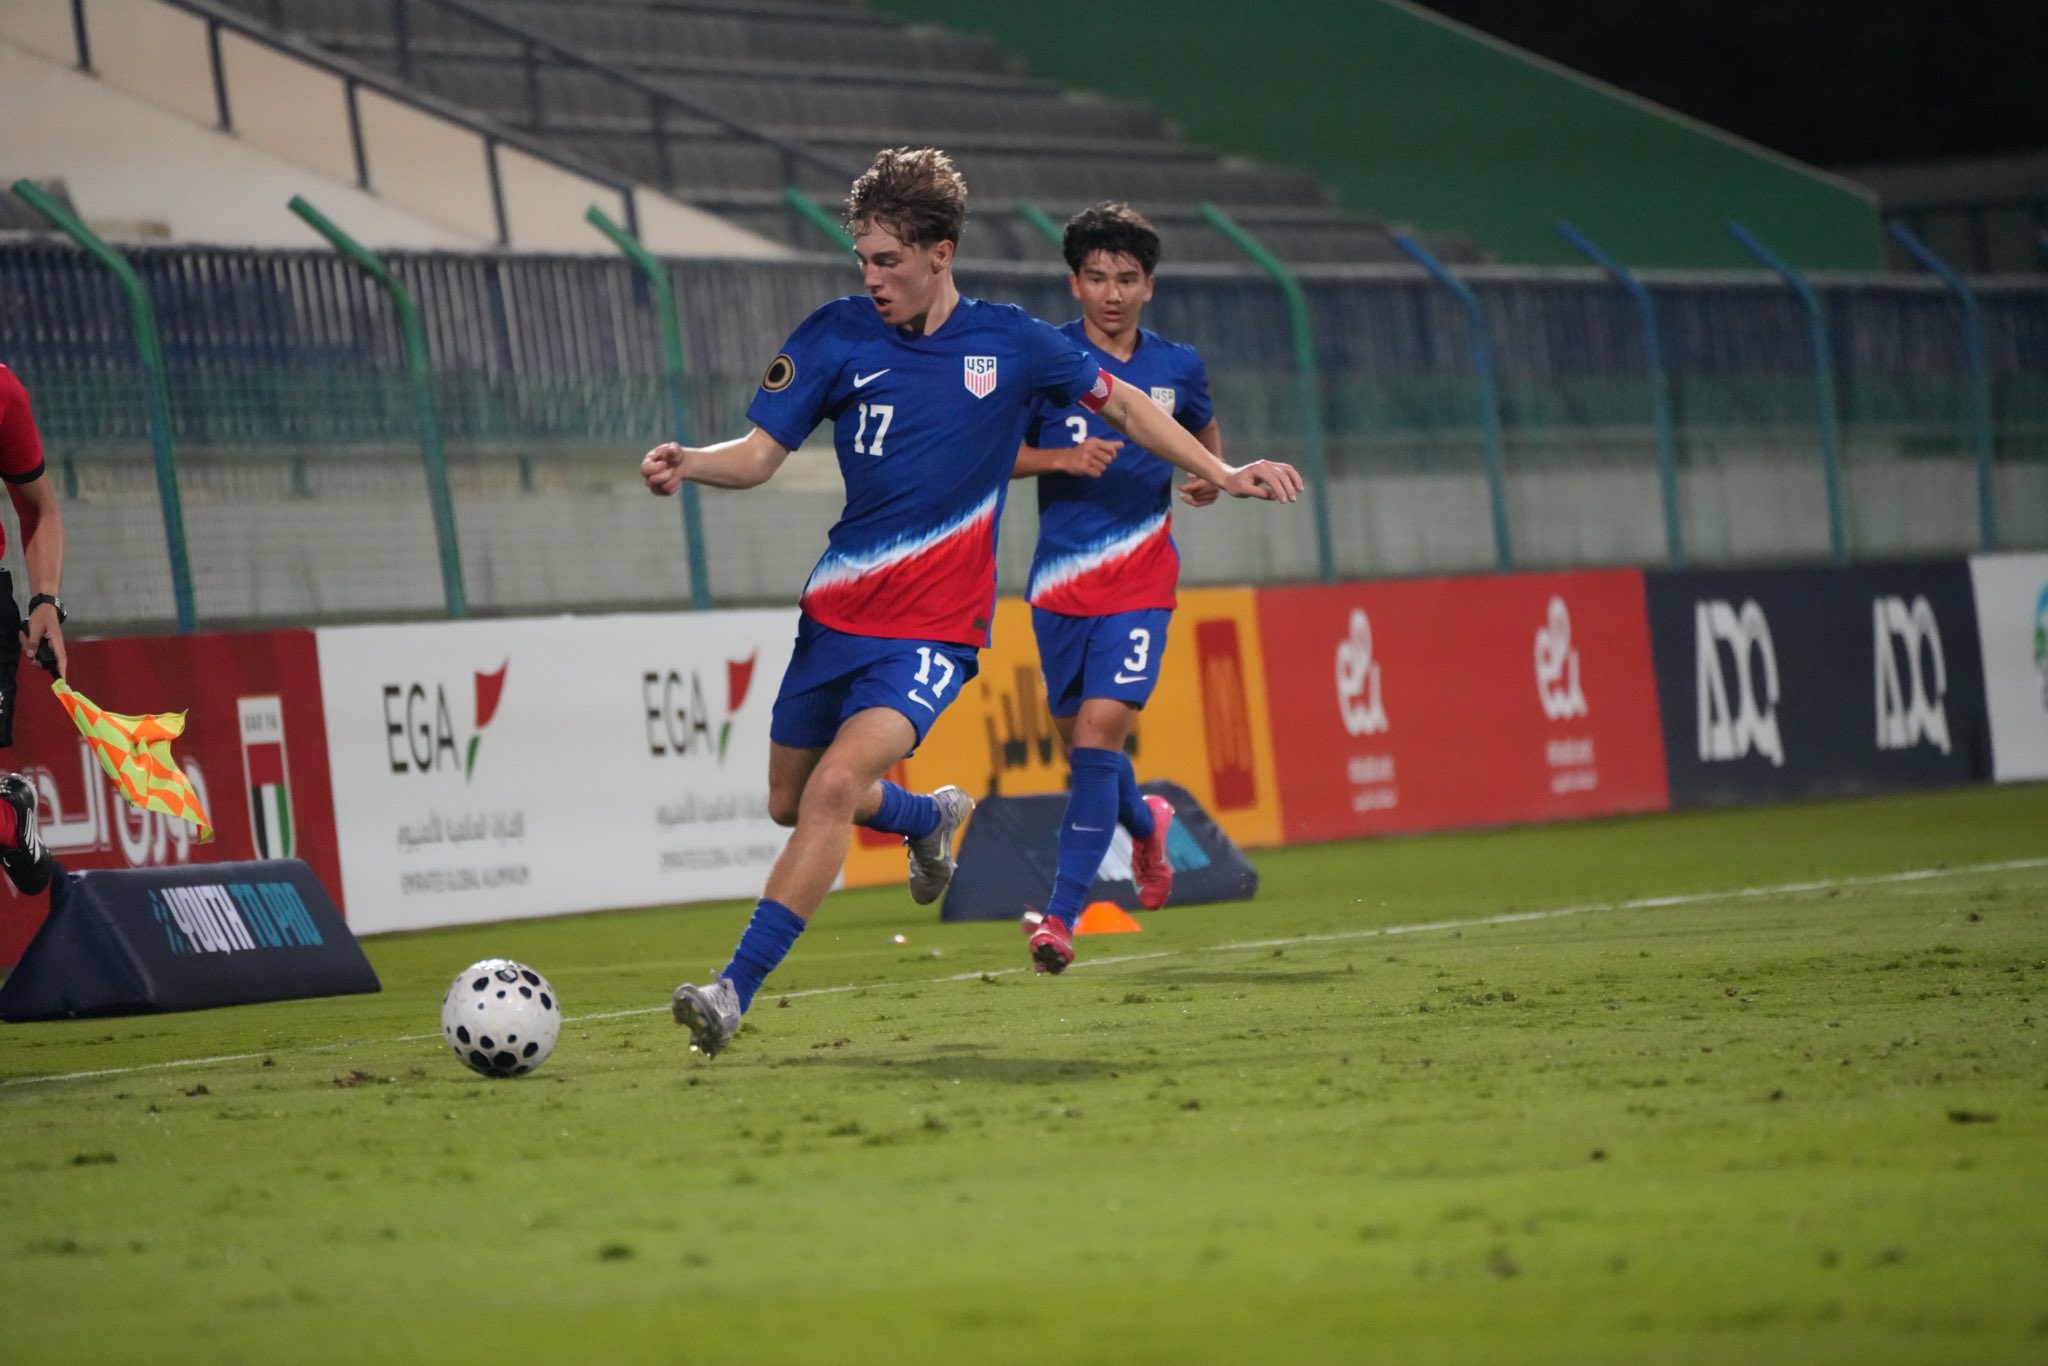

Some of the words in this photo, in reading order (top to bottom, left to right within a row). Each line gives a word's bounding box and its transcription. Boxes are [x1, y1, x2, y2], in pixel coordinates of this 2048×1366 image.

[967, 358, 994, 374] USA
[1153, 388, 1174, 404] USA
[854, 403, 895, 456] 17
[1065, 416, 1087, 444] 3
[914, 646, 955, 699] 17
[1123, 628, 1150, 672] 3
[382, 682, 461, 774] EGA
[641, 670, 715, 758] EGA
[160, 884, 256, 955] YOUTH
